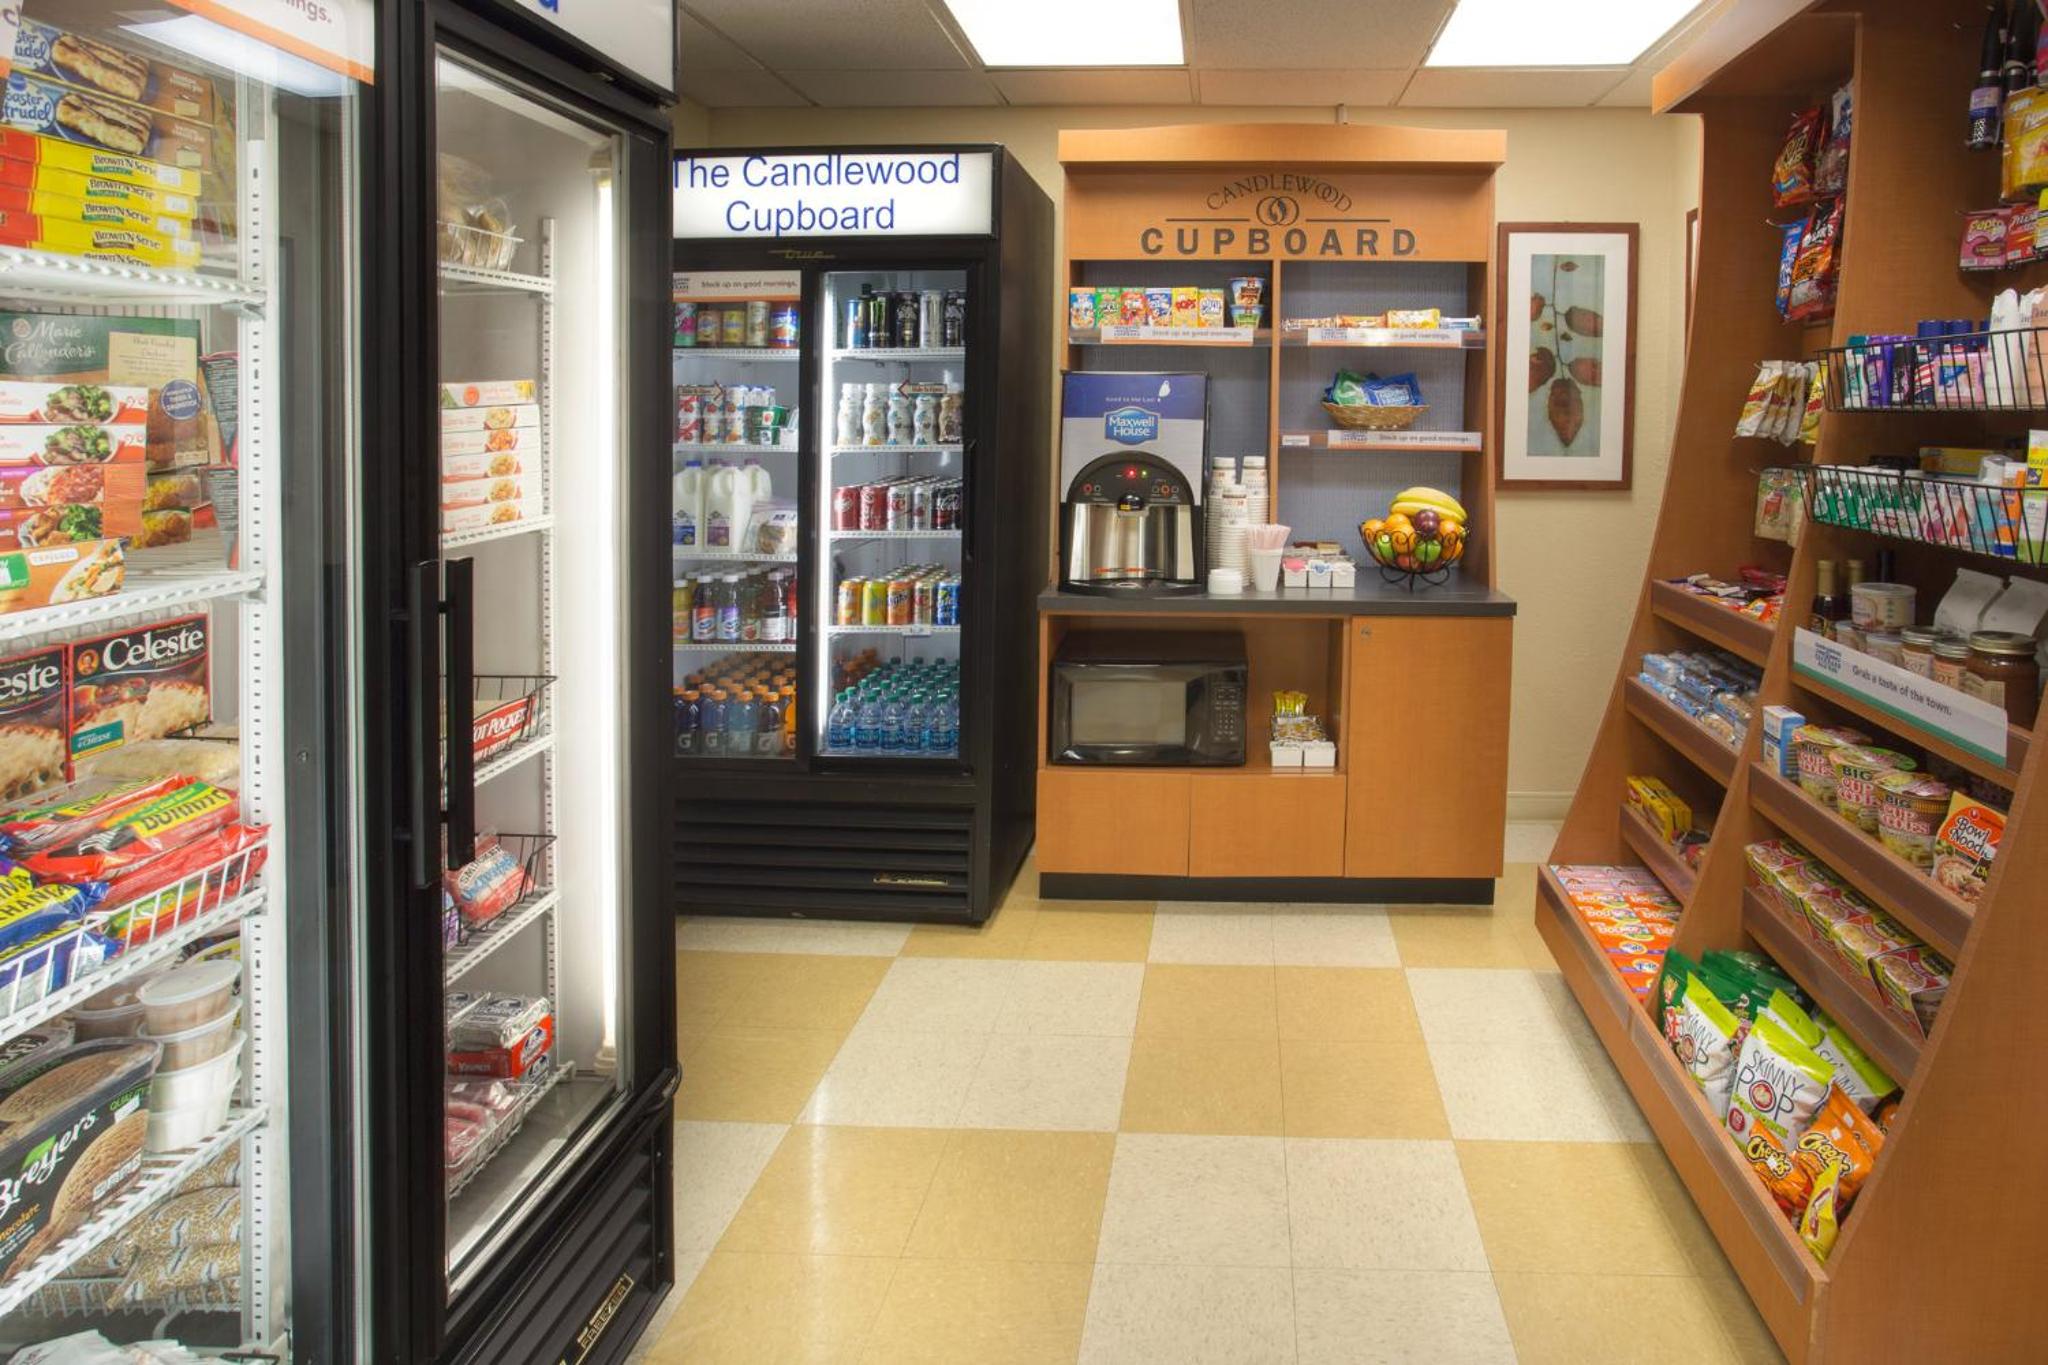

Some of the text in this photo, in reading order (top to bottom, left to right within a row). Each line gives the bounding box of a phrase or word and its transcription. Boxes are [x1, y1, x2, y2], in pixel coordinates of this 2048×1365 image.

[673, 153, 960, 188] The Candlewood
[1206, 173, 1353, 212] CANDLEWOOD
[726, 198, 895, 237] Cupboard
[1140, 227, 1417, 256] CUPBOARD
[27, 320, 83, 345] Marie
[1109, 415, 1155, 428] Maxwell
[1113, 426, 1151, 437] House
[102, 627, 205, 672] Celeste
[1852, 664, 1870, 681] Grab
[1878, 675, 1897, 693] taste
[1899, 686, 1910, 698] of
[1910, 689, 1924, 704] the
[1926, 697, 1952, 716] town.
[1842, 765, 1873, 780] BIG
[1842, 777, 1874, 796] CUP
[1885, 792, 1910, 808] BIG
[1956, 816, 1991, 840] Bowl
